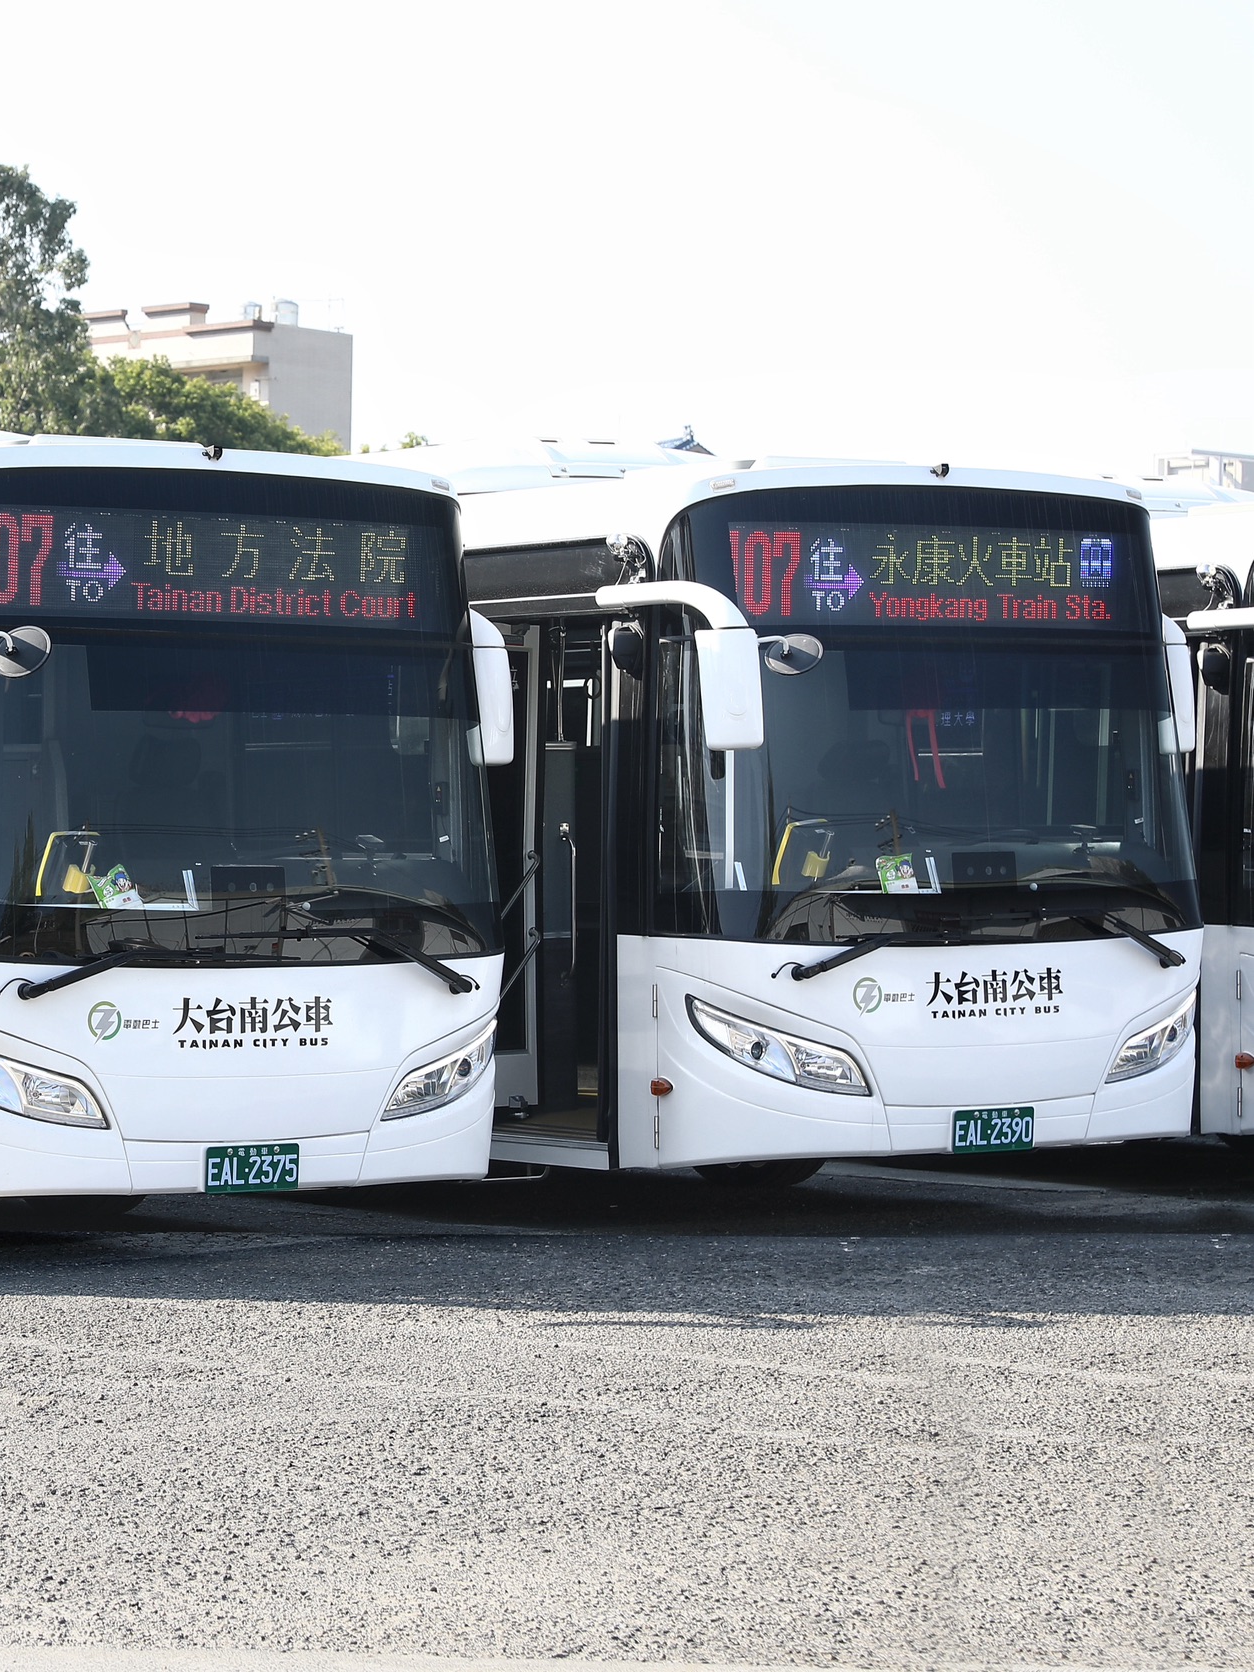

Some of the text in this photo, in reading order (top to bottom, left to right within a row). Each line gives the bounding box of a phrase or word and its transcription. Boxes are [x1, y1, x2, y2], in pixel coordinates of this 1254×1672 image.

[64, 522, 103, 568] 往
[144, 520, 407, 584] 地方法院
[729, 530, 1074, 616] 107 往 永康火車站
[65, 579, 416, 618] TO Tainan District Court
[811, 590, 1112, 622] TO Yongkang Train Sta.
[926, 967, 1064, 1008] 大台南公車
[123, 1019, 160, 1030] 電動巴士
[172, 996, 334, 1035] 大台南公車
[931, 1005, 1060, 1020] TAINAN CITY BUS
[178, 1037, 329, 1050] TAINAN CITY BUS
